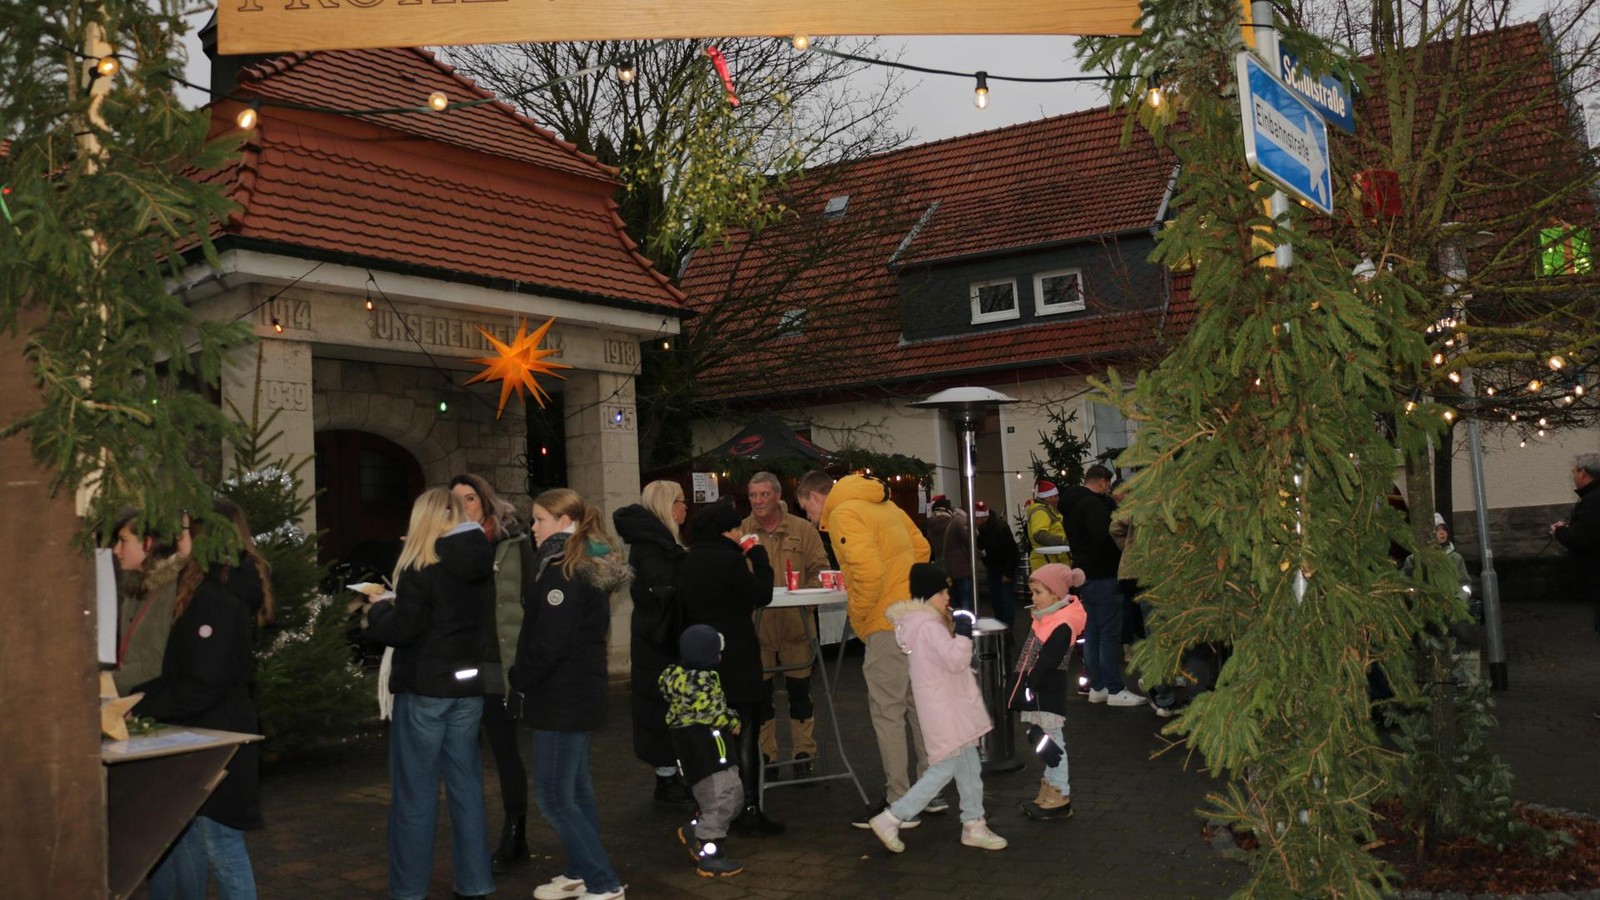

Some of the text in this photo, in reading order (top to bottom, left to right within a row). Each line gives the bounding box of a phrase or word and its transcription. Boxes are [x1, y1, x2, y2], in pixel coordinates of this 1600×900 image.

[1255, 103, 1310, 162] Einbahnstraße
[262, 298, 311, 330] 1914
[376, 311, 562, 357] UNSEREN HEN
[604, 340, 636, 366] 1918
[260, 380, 308, 412] 1939
